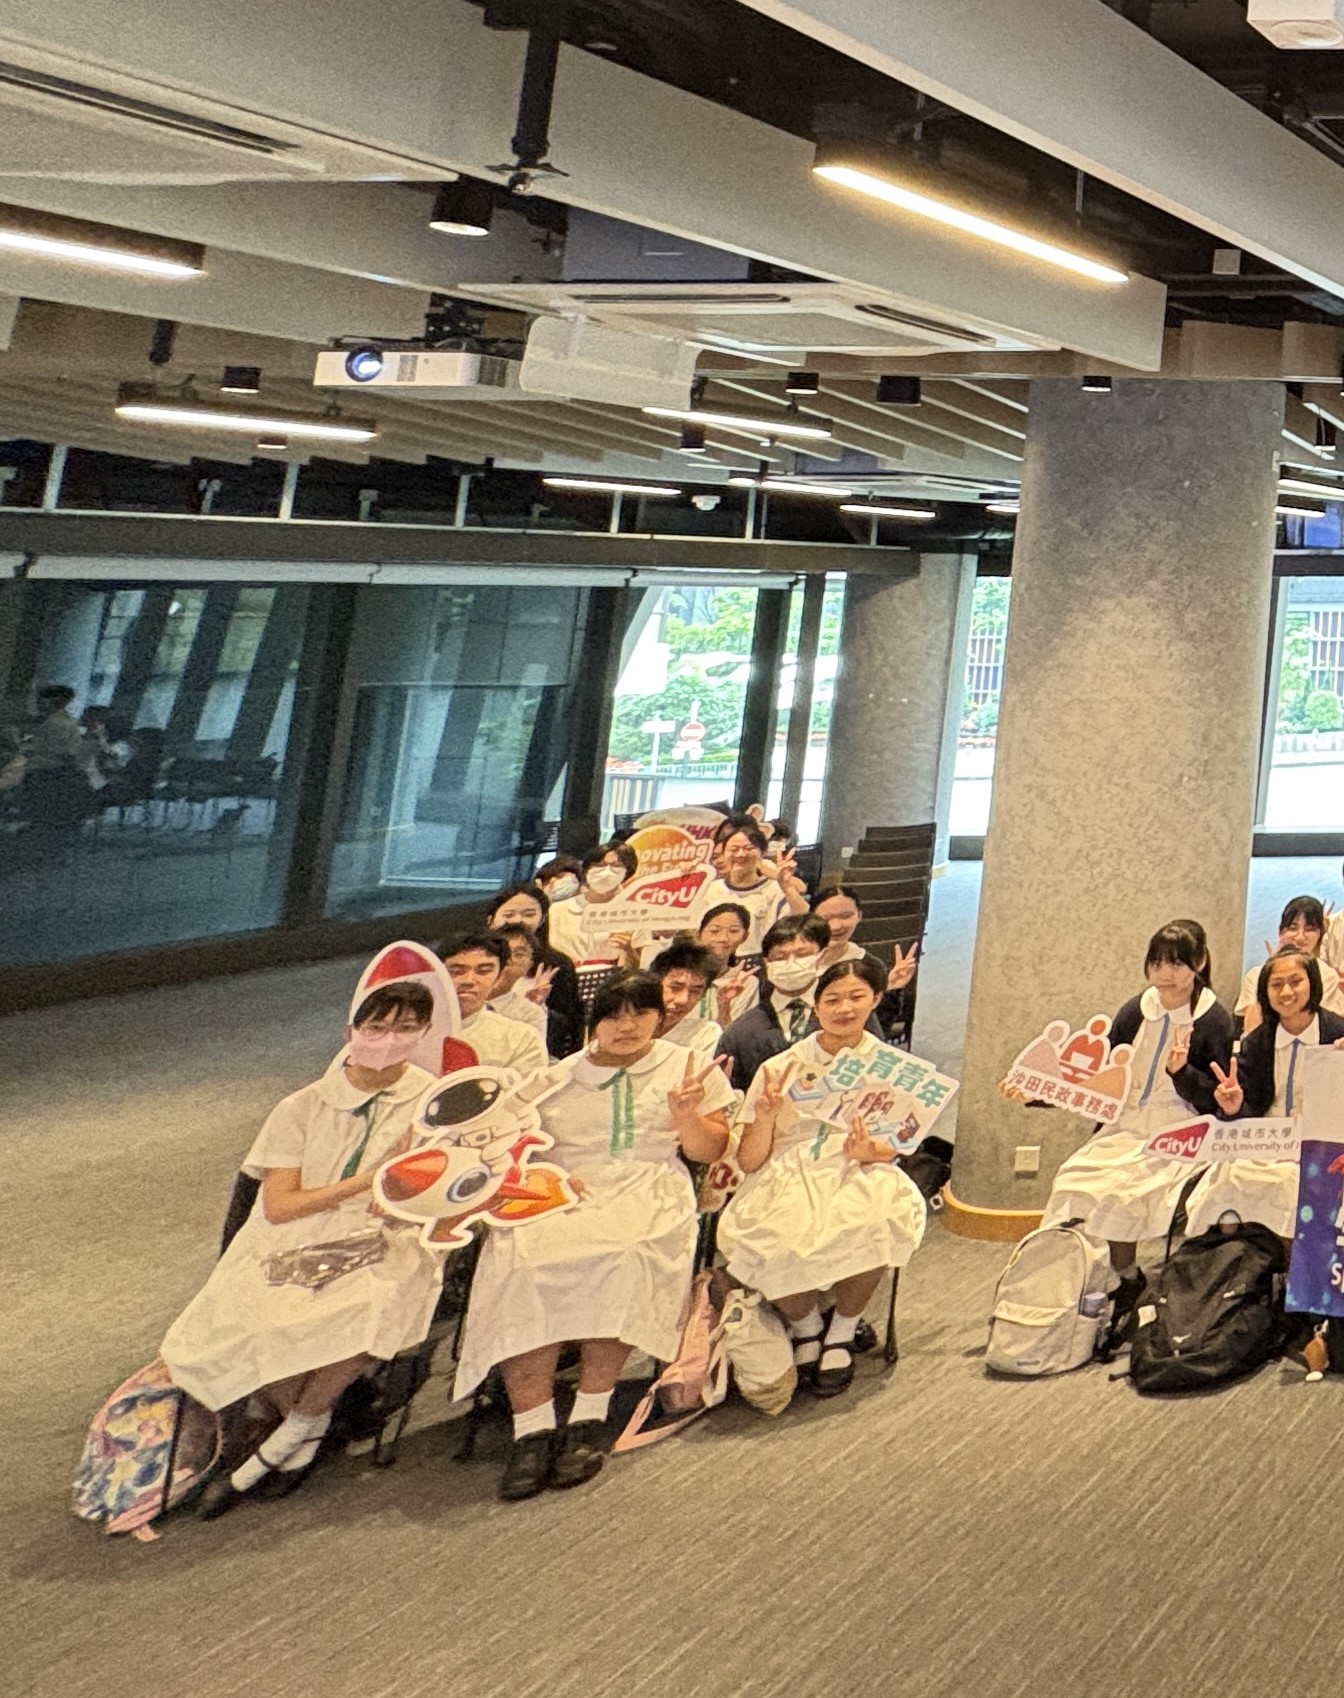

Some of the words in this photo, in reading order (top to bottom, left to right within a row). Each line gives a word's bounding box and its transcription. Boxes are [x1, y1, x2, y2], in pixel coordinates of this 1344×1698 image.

[640, 841, 708, 865] ovating
[635, 886, 697, 906] CityU
[829, 1050, 950, 1109] 培育青年
[1008, 1070, 1118, 1121] 沙田民政事務處
[1214, 1127, 1292, 1140] 香港城市大學
[1154, 1136, 1202, 1160] CityU
[1211, 1142, 1231, 1153] City
